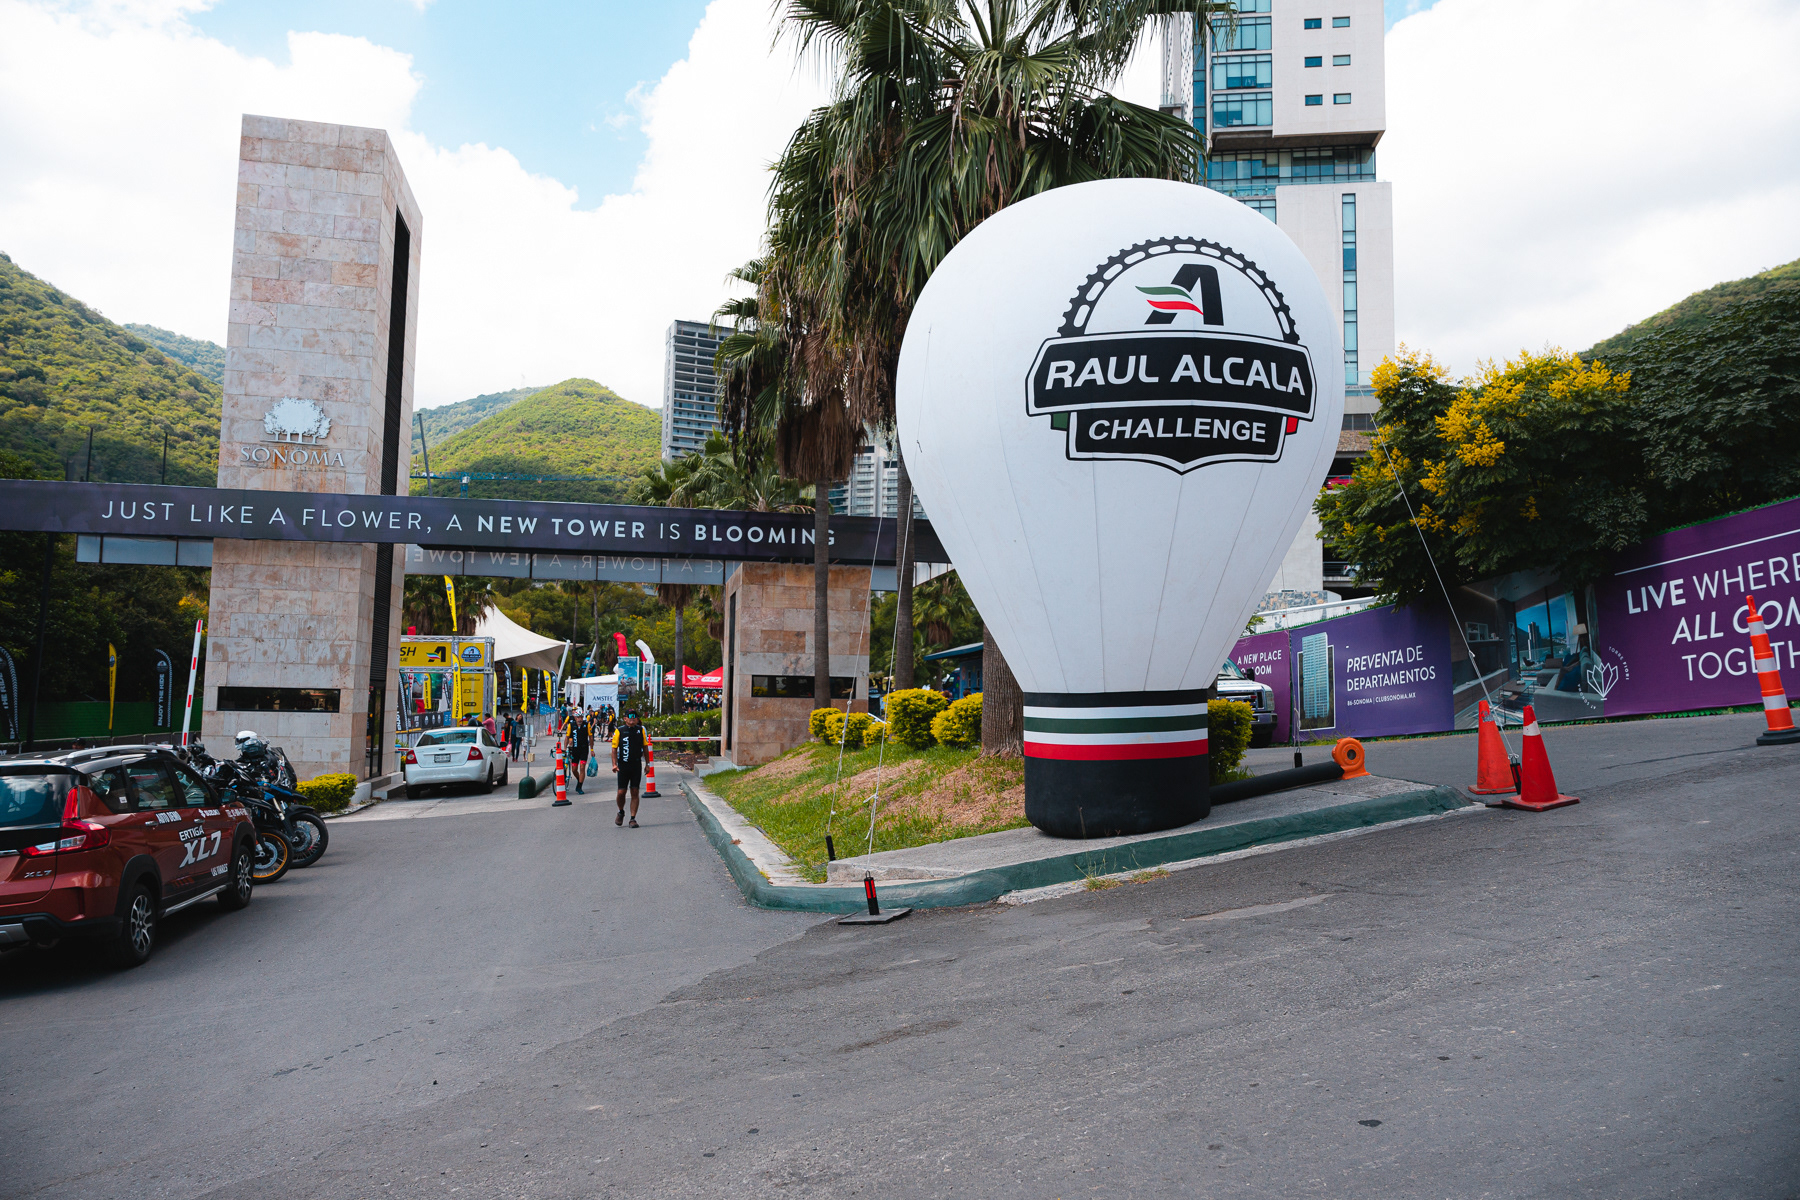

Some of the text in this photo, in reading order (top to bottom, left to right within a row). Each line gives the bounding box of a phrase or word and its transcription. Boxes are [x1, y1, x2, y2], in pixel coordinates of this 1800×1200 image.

[1045, 354, 1305, 396] RAUL ALCALA
[1088, 417, 1266, 443] CHALLENGE
[240, 446, 345, 467] SONOMA
[101, 500, 174, 521] JUST
[190, 504, 254, 524] LIKE
[268, 507, 286, 525] A
[302, 508, 432, 534] FLOWER,
[446, 514, 463, 531] A
[477, 515, 538, 535] NEW
[551, 518, 645, 539] TOWER
[660, 523, 681, 540] IS
[1627, 578, 1686, 614] LIVE
[1671, 611, 1724, 645] ALL
[1237, 649, 1282, 665] A NEW PLACE
[1347, 645, 1423, 673] PREVENTA DE
[1347, 666, 1436, 691] DEPARTAMENTOS
[179, 825, 205, 841] ERTIGA
[179, 831, 221, 868] XL7
[24, 869, 52, 878] XL7
